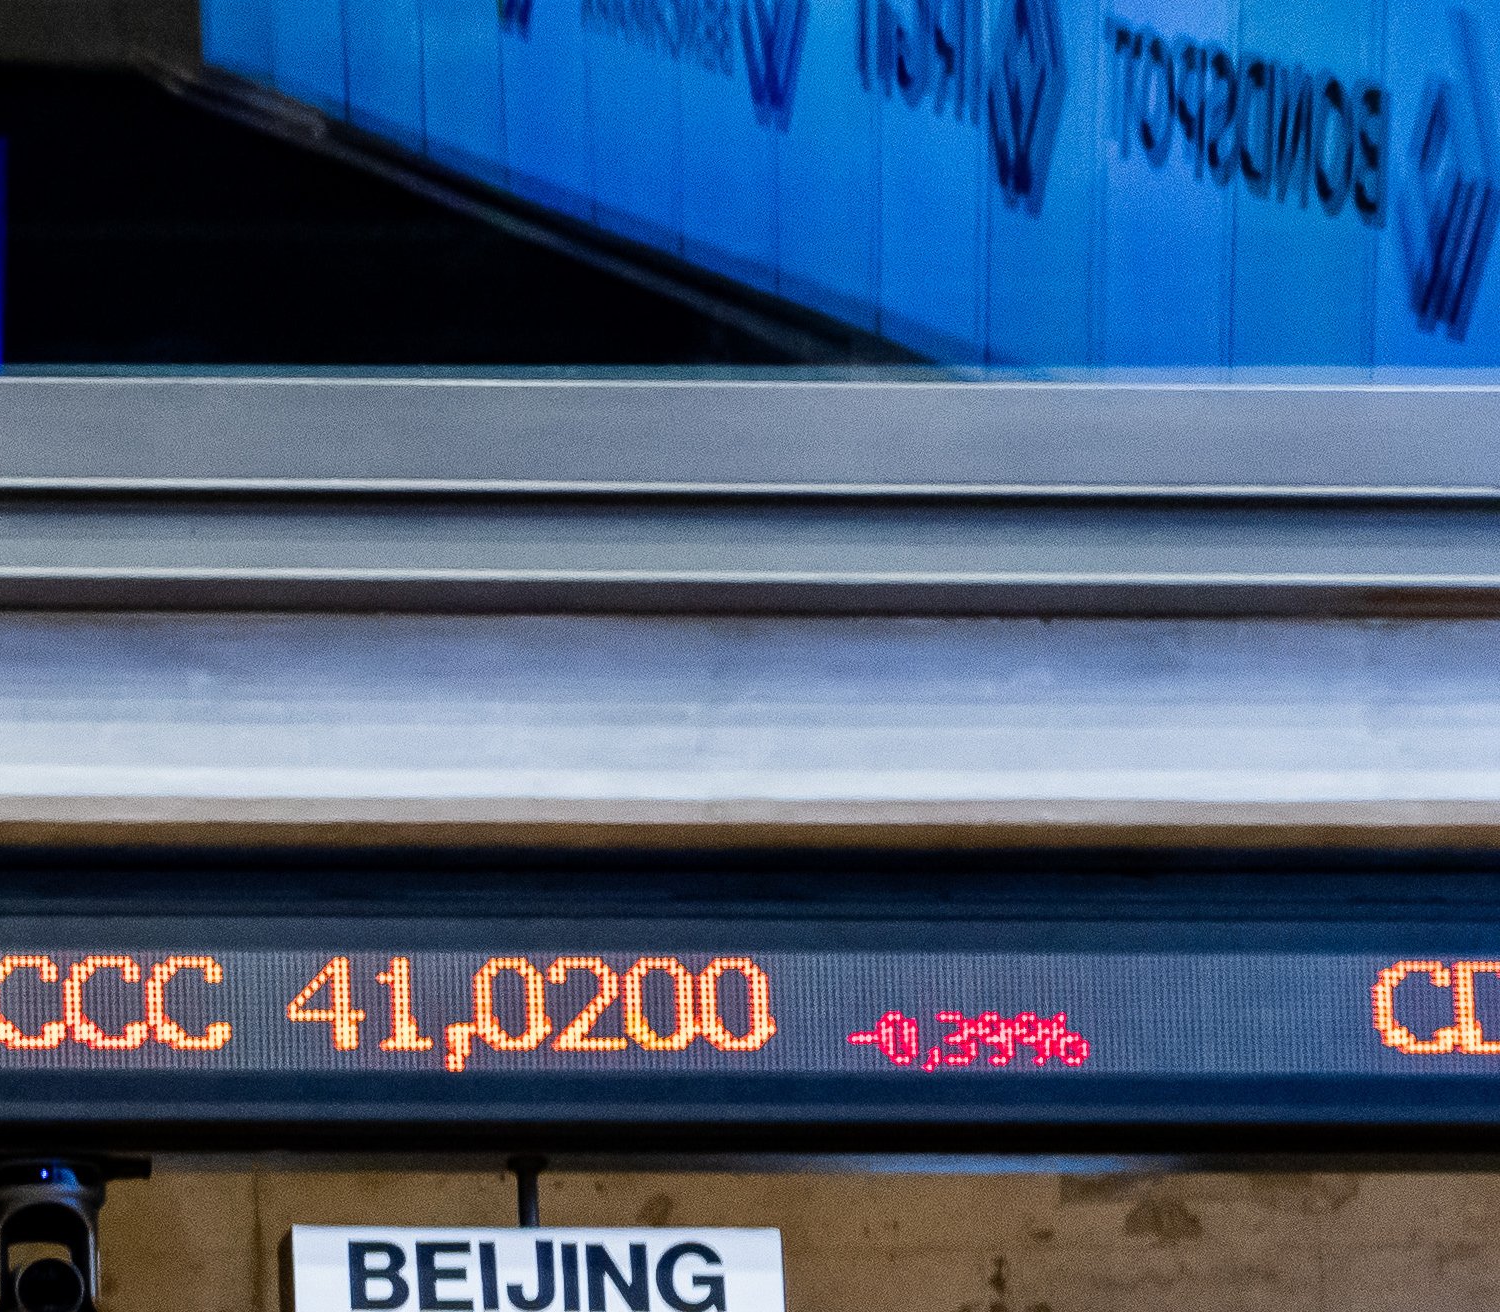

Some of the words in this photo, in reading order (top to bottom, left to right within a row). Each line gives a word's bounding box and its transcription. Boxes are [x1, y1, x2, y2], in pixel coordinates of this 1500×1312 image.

[287, 958, 776, 1072] 41,0200
[848, 1012, 1089, 1072] -0,39%
[349, 1241, 725, 1312] BEIJING
